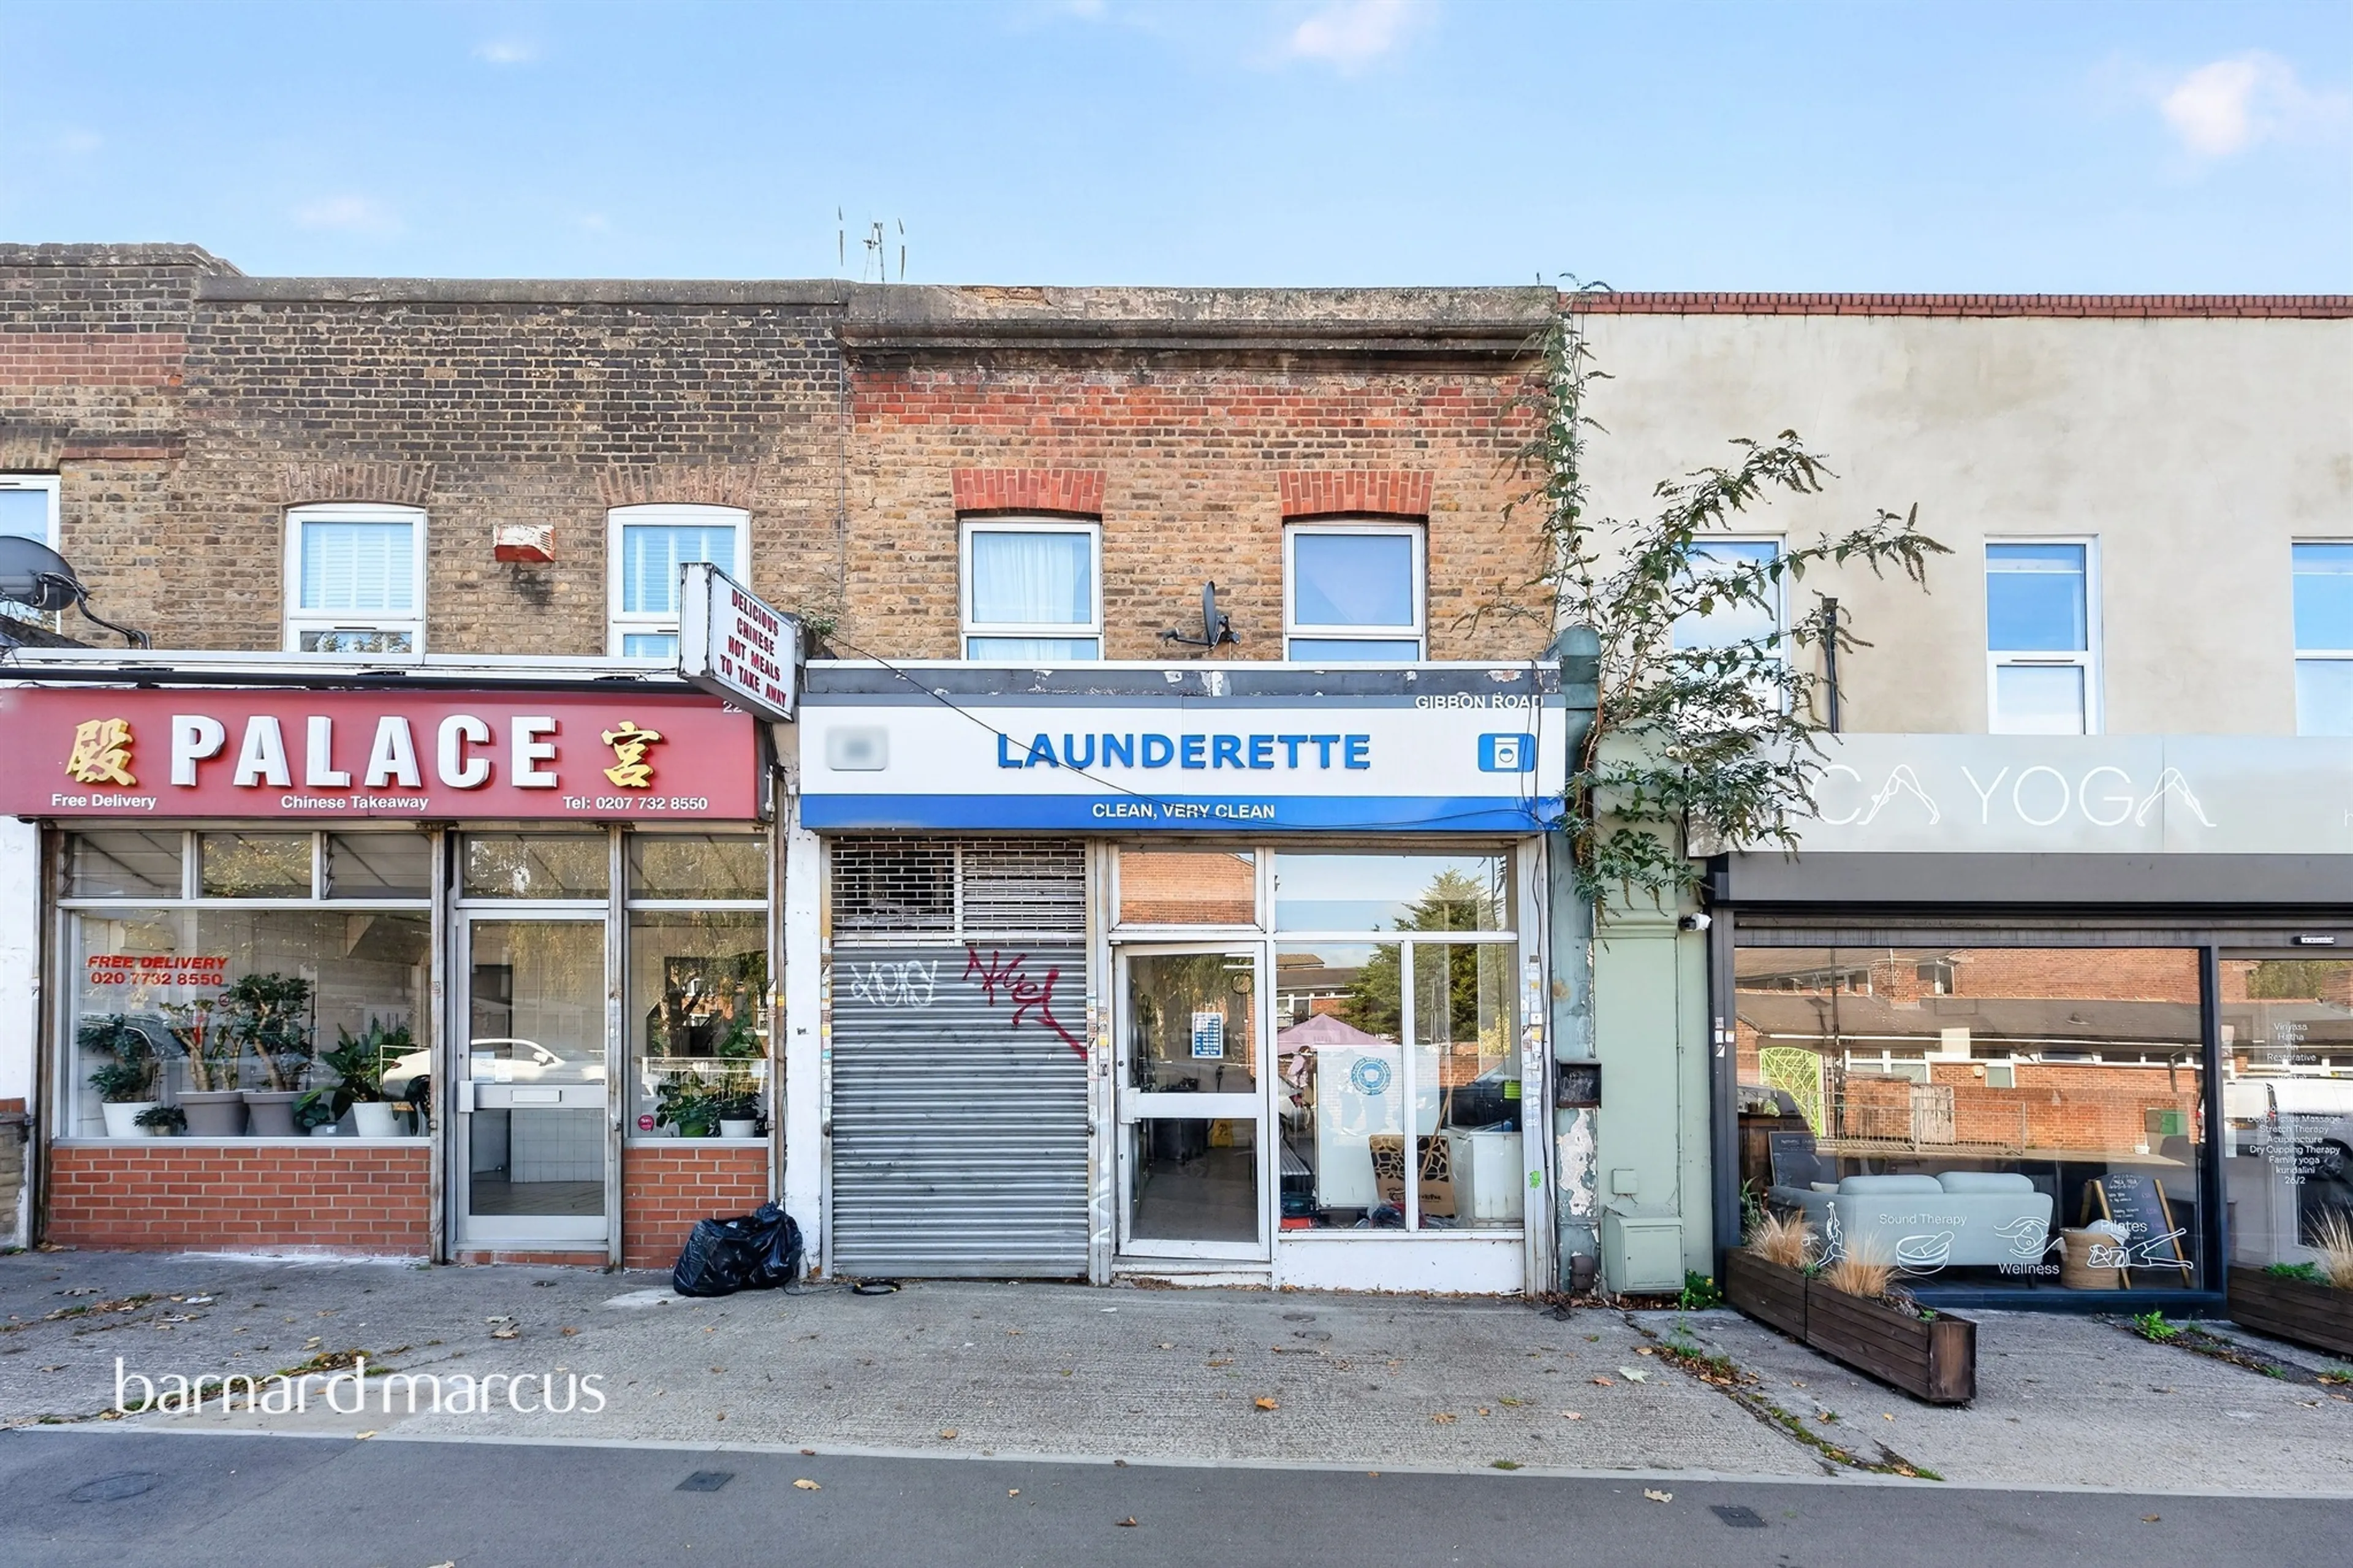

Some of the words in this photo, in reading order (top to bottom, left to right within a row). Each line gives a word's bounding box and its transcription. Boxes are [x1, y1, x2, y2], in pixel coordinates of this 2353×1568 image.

[732, 589, 778, 637] DELICIOUS
[737, 618, 775, 657] CHINESE
[728, 635, 746, 661] HOT
[751, 651, 780, 682] MEALS
[720, 654, 732, 676] TO
[738, 665, 760, 693] TAKE
[765, 683, 786, 708] AWAY
[1415, 694, 1485, 709] GIBBON
[1492, 694, 1544, 709] ROAD
[172, 714, 558, 789] PALACE
[998, 733, 1371, 770] LAUNDERETTE
[51, 793, 87, 806] Free
[92, 793, 157, 810] Delivery
[281, 795, 346, 809] Chinese
[350, 795, 429, 811] Takeaway
[563, 796, 591, 809] Tel:
[596, 797, 632, 809] 0207
[638, 797, 665, 809] 732
[670, 797, 708, 810] 8550
[1960, 765, 2217, 828] YOGA
[1092, 803, 1158, 820] CLEAN,
[1161, 804, 1210, 819] VERY
[1215, 804, 1275, 819] CLEAN
[87, 956, 134, 968] FREE
[140, 956, 229, 969] DELIVERY
[91, 972, 126, 984] 020
[130, 972, 172, 985] 7732
[176, 973, 223, 985] 8550
[2273, 1022, 2308, 1032] Vinyasa
[2295, 1125, 2329, 1134] Therapy
[2267, 1135, 2323, 1145] Acupuncture
[2249, 1145, 2265, 1155] Dry
[2267, 1145, 2303, 1155] Cupping
[2305, 1145, 2340, 1155] Therapy
[2269, 1156, 2297, 1165] Family
[1879, 1214, 1917, 1224] Sound
[1921, 1214, 1967, 1225] Therapy
[2101, 1220, 2148, 1232] Pilates
[1998, 1262, 2060, 1275] Wellness
